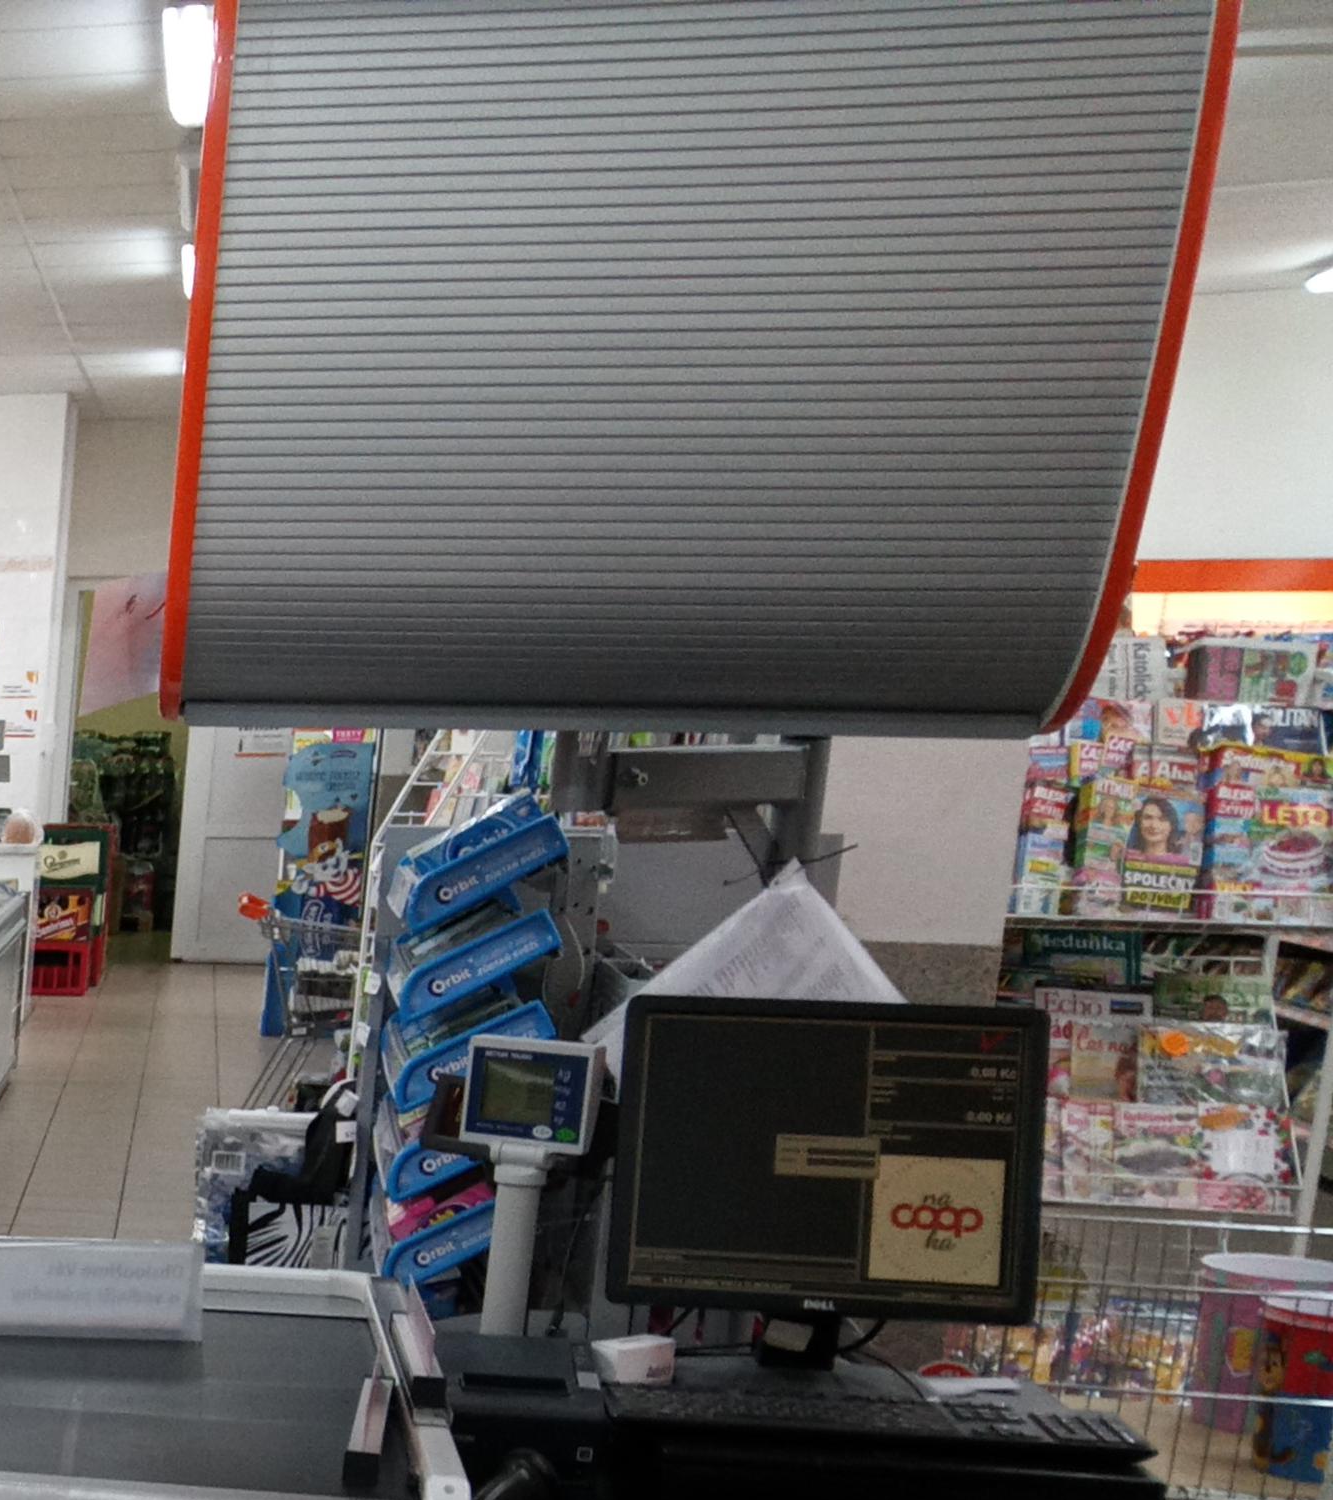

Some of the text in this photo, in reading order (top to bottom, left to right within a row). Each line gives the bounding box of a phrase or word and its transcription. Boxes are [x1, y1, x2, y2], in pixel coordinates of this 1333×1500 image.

[436, 875, 480, 905] Orbit
[428, 967, 473, 997] Orbit
[1043, 991, 1103, 1017] Echo
[890, 1203, 984, 1238] coop
[413, 1240, 456, 1268] Orbit
[803, 1299, 836, 1311] DELL
